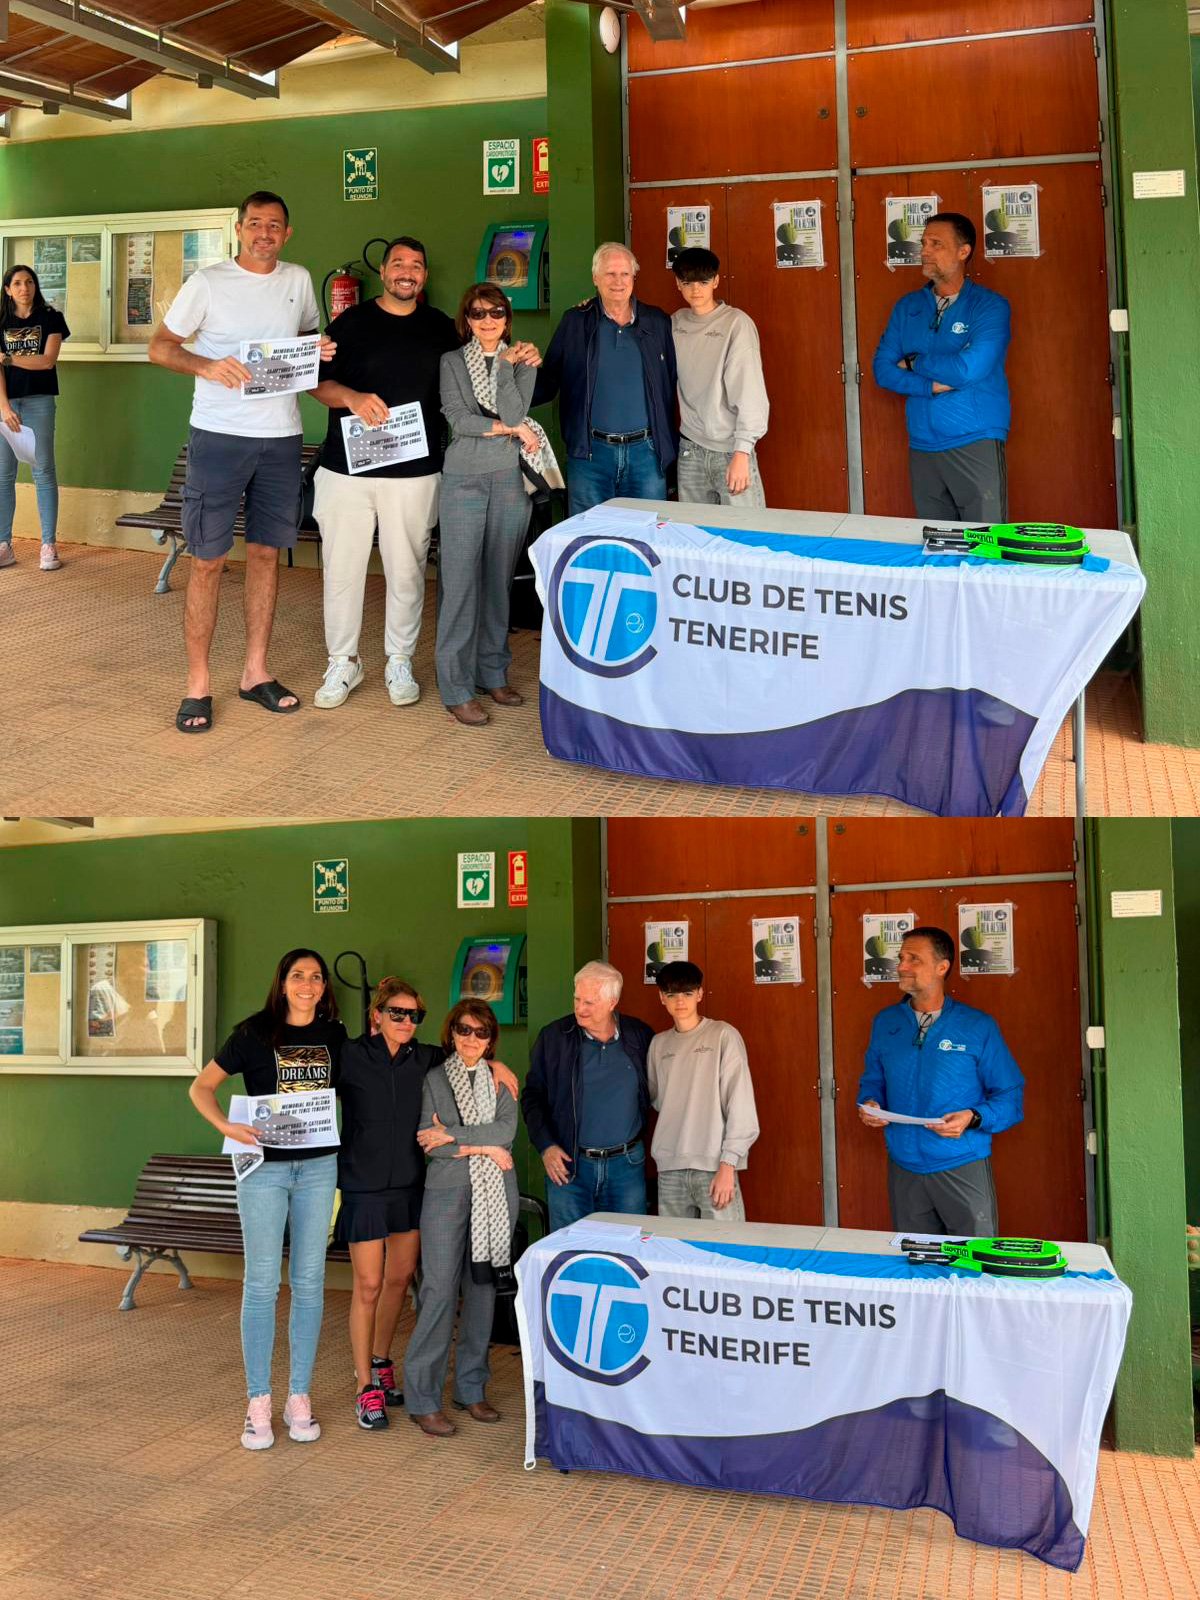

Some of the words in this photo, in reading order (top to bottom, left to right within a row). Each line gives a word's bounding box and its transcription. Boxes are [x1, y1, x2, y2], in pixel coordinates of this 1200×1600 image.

[488, 141, 515, 150] ESPACIO
[7, 340, 38, 350] DREAMS
[389, 422, 400, 430] TENIS
[401, 418, 419, 426] TENERIFE
[672, 573, 751, 606] CLUB
[763, 584, 806, 612] DE
[814, 588, 909, 621] TENIS
[668, 617, 819, 660] TENERIFE
[463, 854, 490, 863] ESPACIO
[281, 1065, 327, 1080] DREAMS
[281, 1102, 304, 1110] MEMORIAL
[662, 1286, 742, 1317] CLUB
[753, 1296, 795, 1322] DE
[803, 1299, 896, 1330] TENIS
[661, 1328, 811, 1367] TENERIFE
